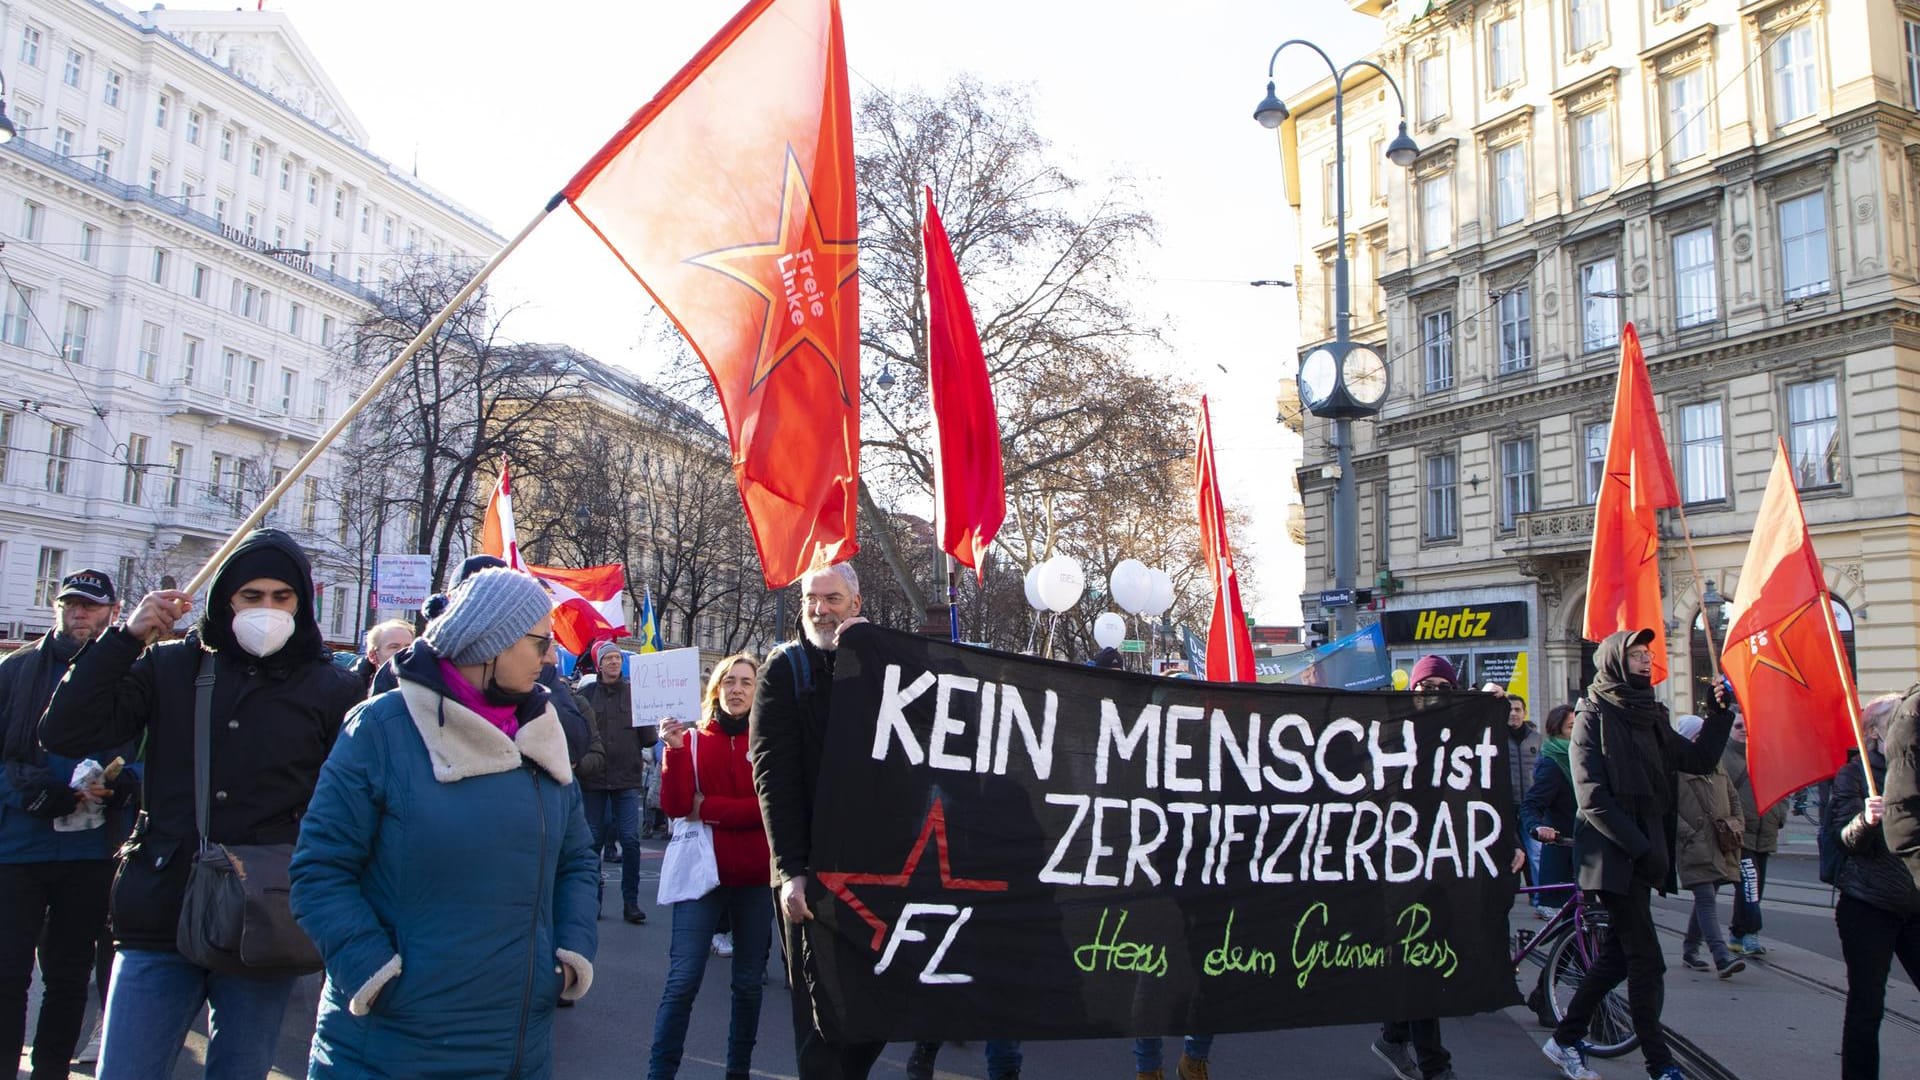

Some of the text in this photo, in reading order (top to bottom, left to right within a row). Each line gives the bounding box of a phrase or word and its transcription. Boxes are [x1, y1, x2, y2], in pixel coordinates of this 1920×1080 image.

[221, 223, 259, 251] HOTEL
[777, 253, 804, 326] Linke
[796, 248, 824, 318] Freie
[378, 595, 425, 605] FAKE-Pandemi
[1414, 607, 1492, 641] Hertz
[872, 664, 1498, 796] KEIN MENSCH ist
[1038, 793, 1502, 887] ZERTIFIZIERBAR
[1741, 858, 1759, 902] PLATINUM
[1203, 907, 1276, 977] dem
[1396, 903, 1459, 978] Pass
